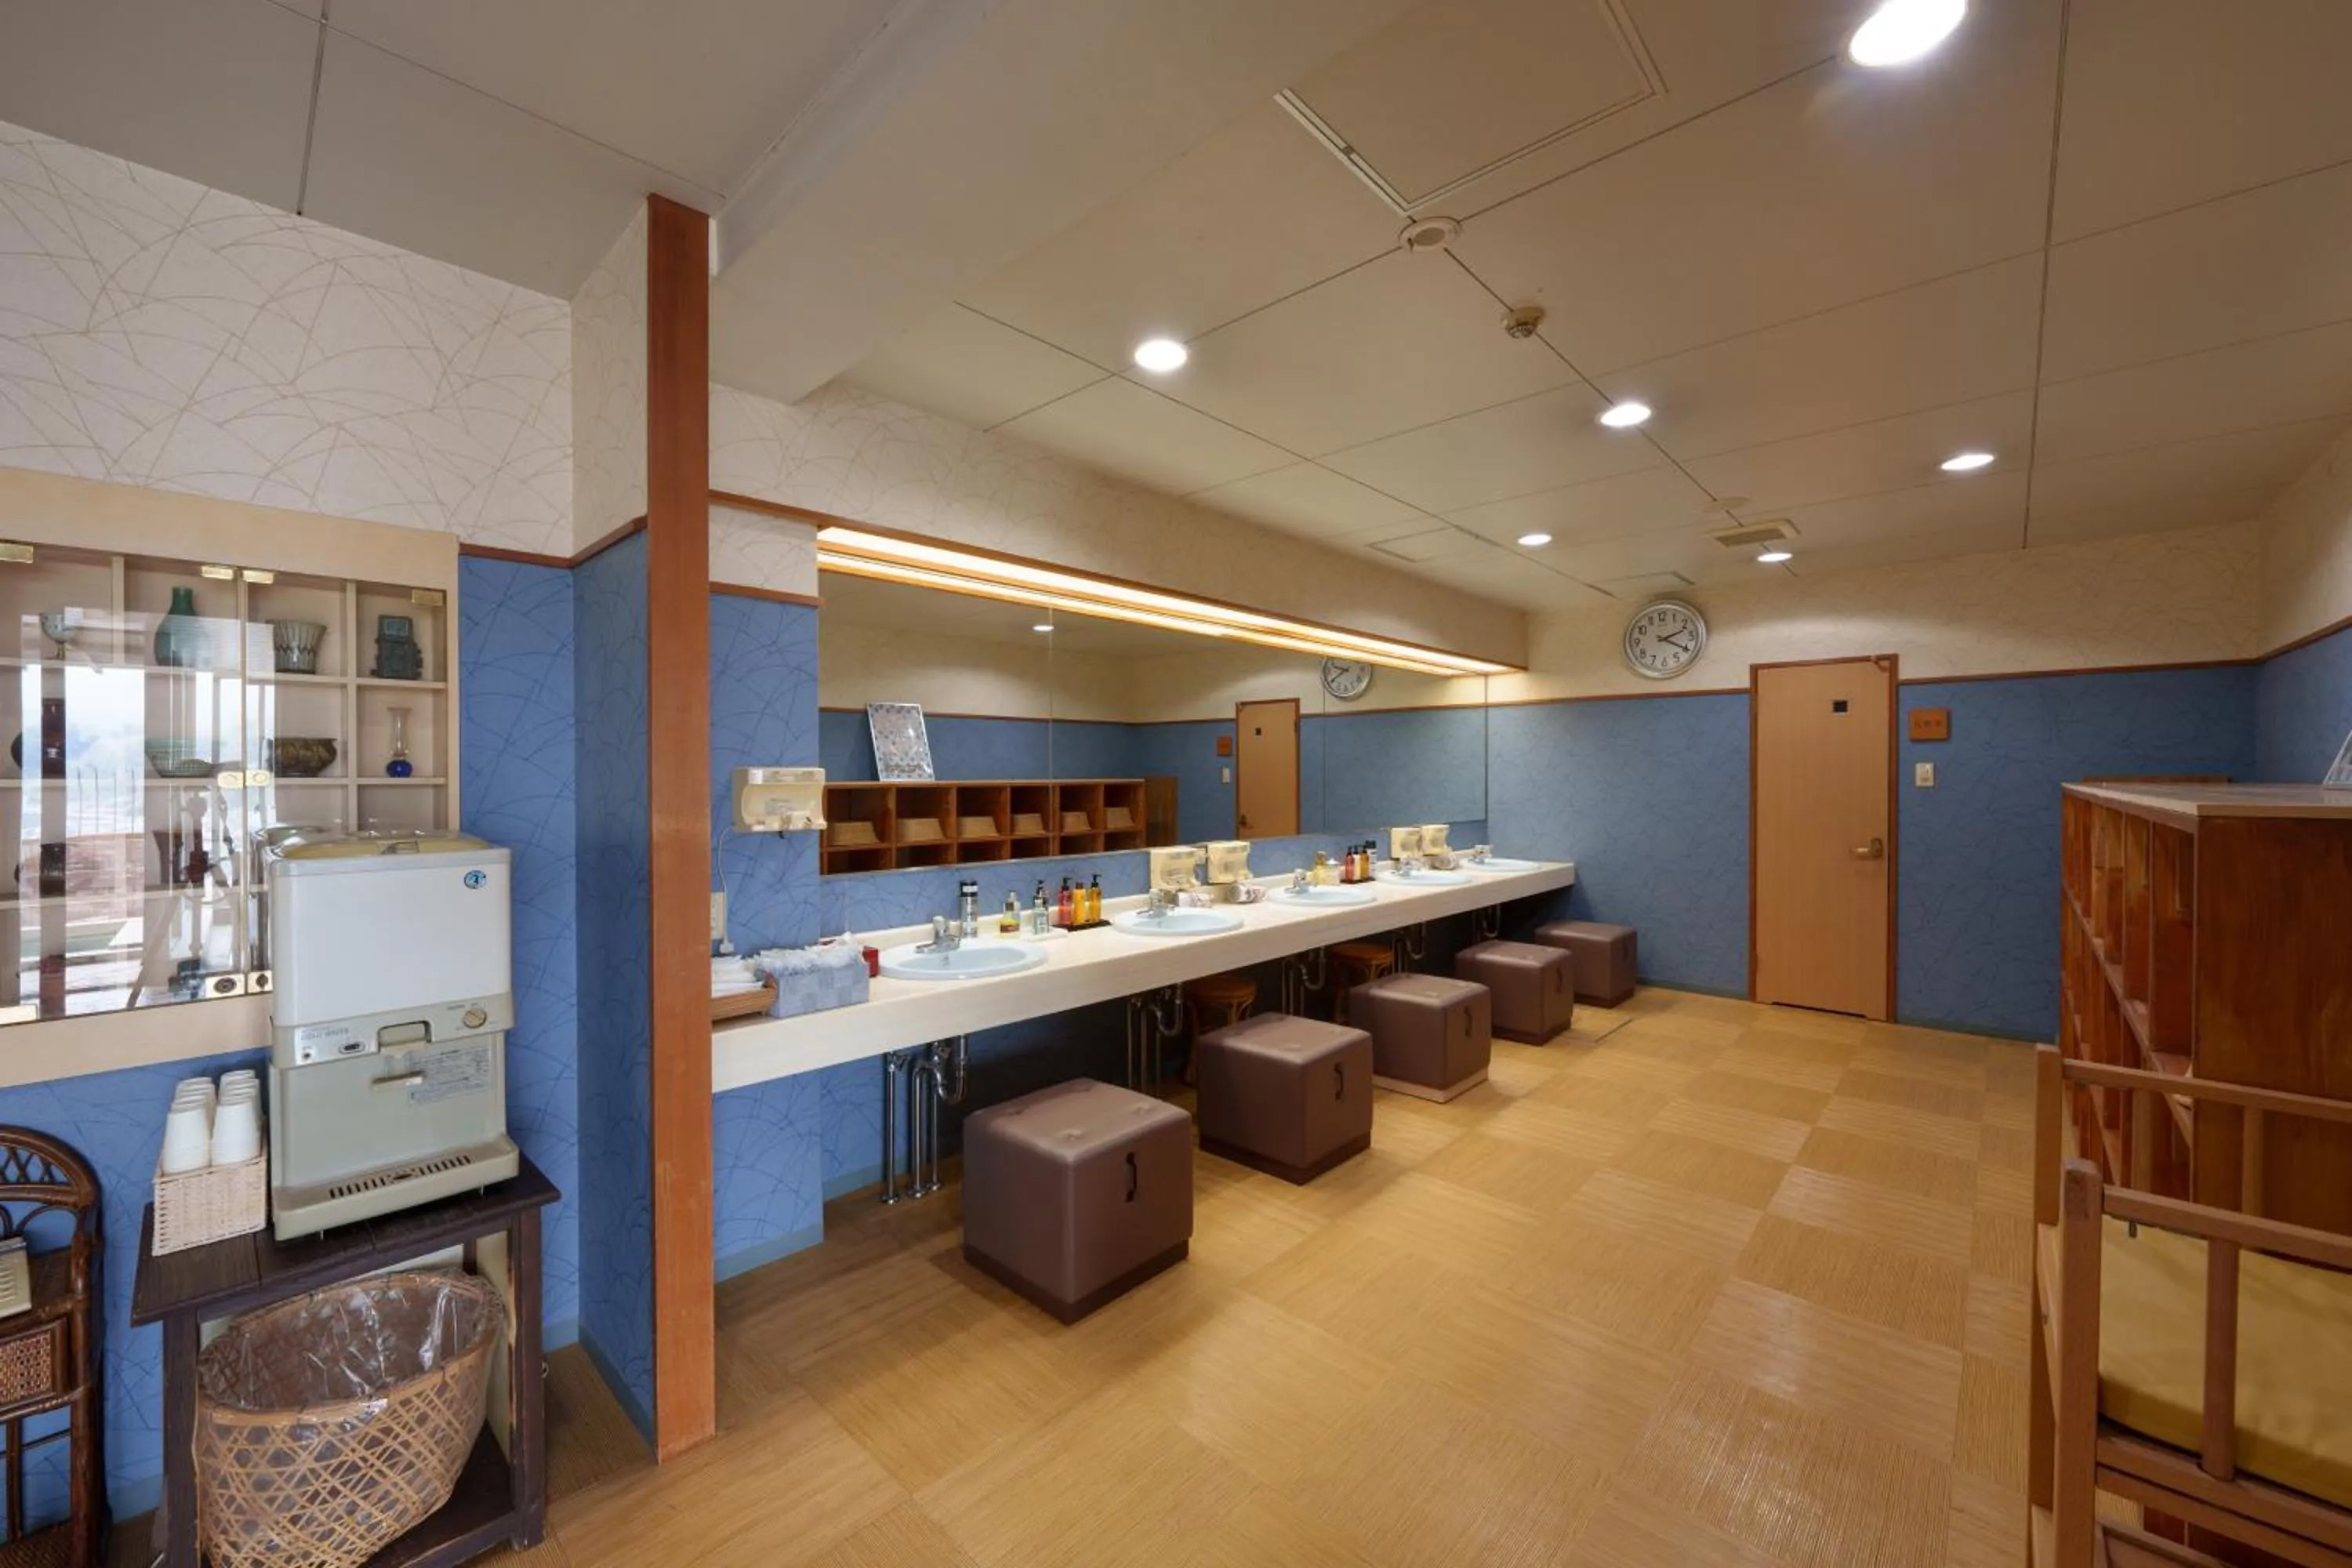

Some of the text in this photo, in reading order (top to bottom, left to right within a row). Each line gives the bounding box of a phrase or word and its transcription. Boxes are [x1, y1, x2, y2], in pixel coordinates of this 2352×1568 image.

[1657, 612, 1667, 622] 12
[1638, 624, 1647, 635] 10
[1681, 618, 1688, 630] 2
[1634, 637, 1641, 648] 9
[1639, 648, 1646, 659] 8
[1649, 655, 1657, 666] 7
[1661, 656, 1668, 666] 6
